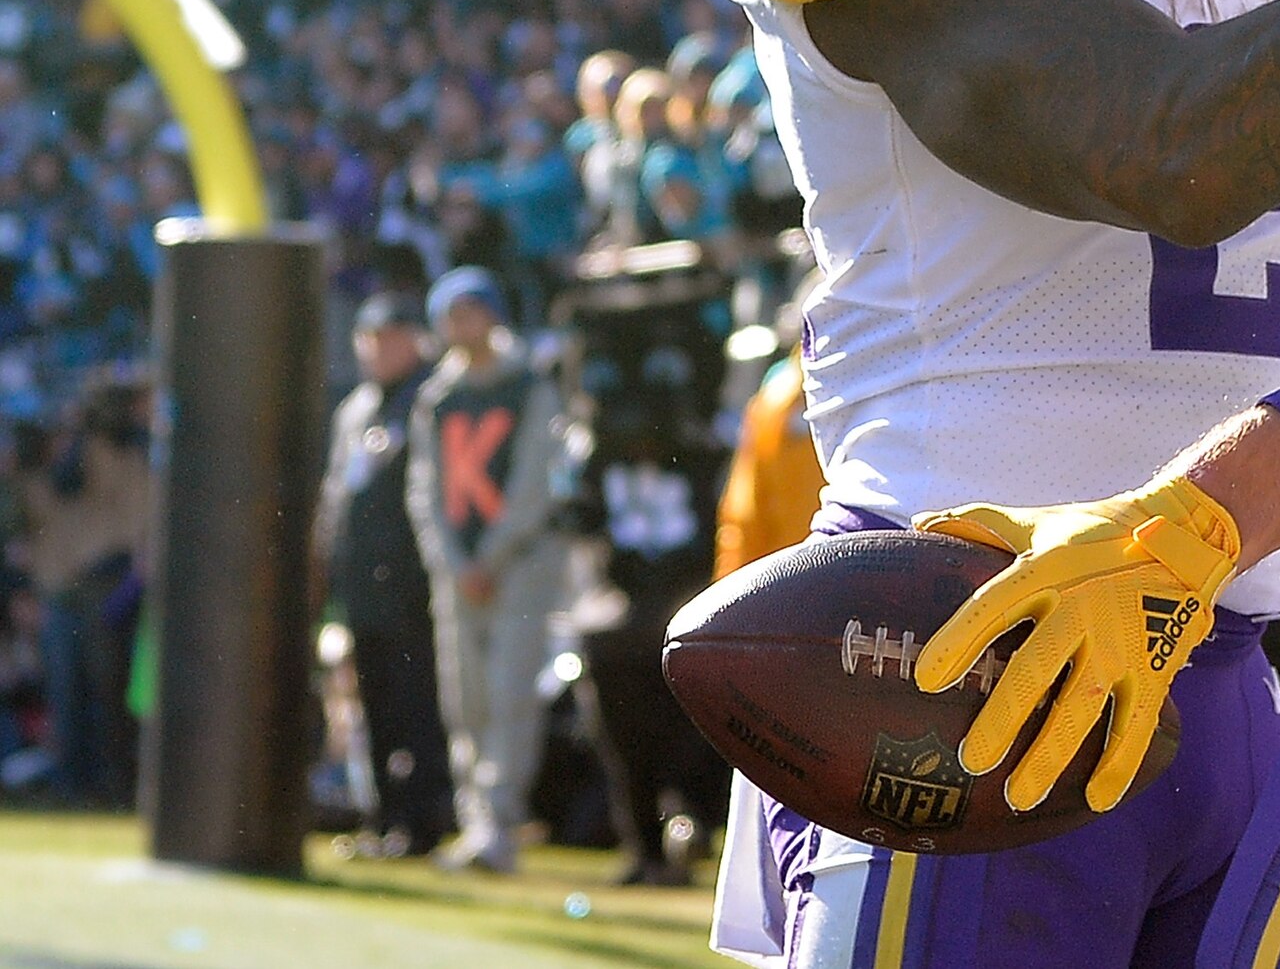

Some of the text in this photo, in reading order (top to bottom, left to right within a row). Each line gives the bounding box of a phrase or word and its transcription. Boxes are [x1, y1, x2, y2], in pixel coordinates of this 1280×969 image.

[439, 407, 514, 524] K
[1150, 596, 1200, 672] adidas
[864, 773, 963, 828] NFL
